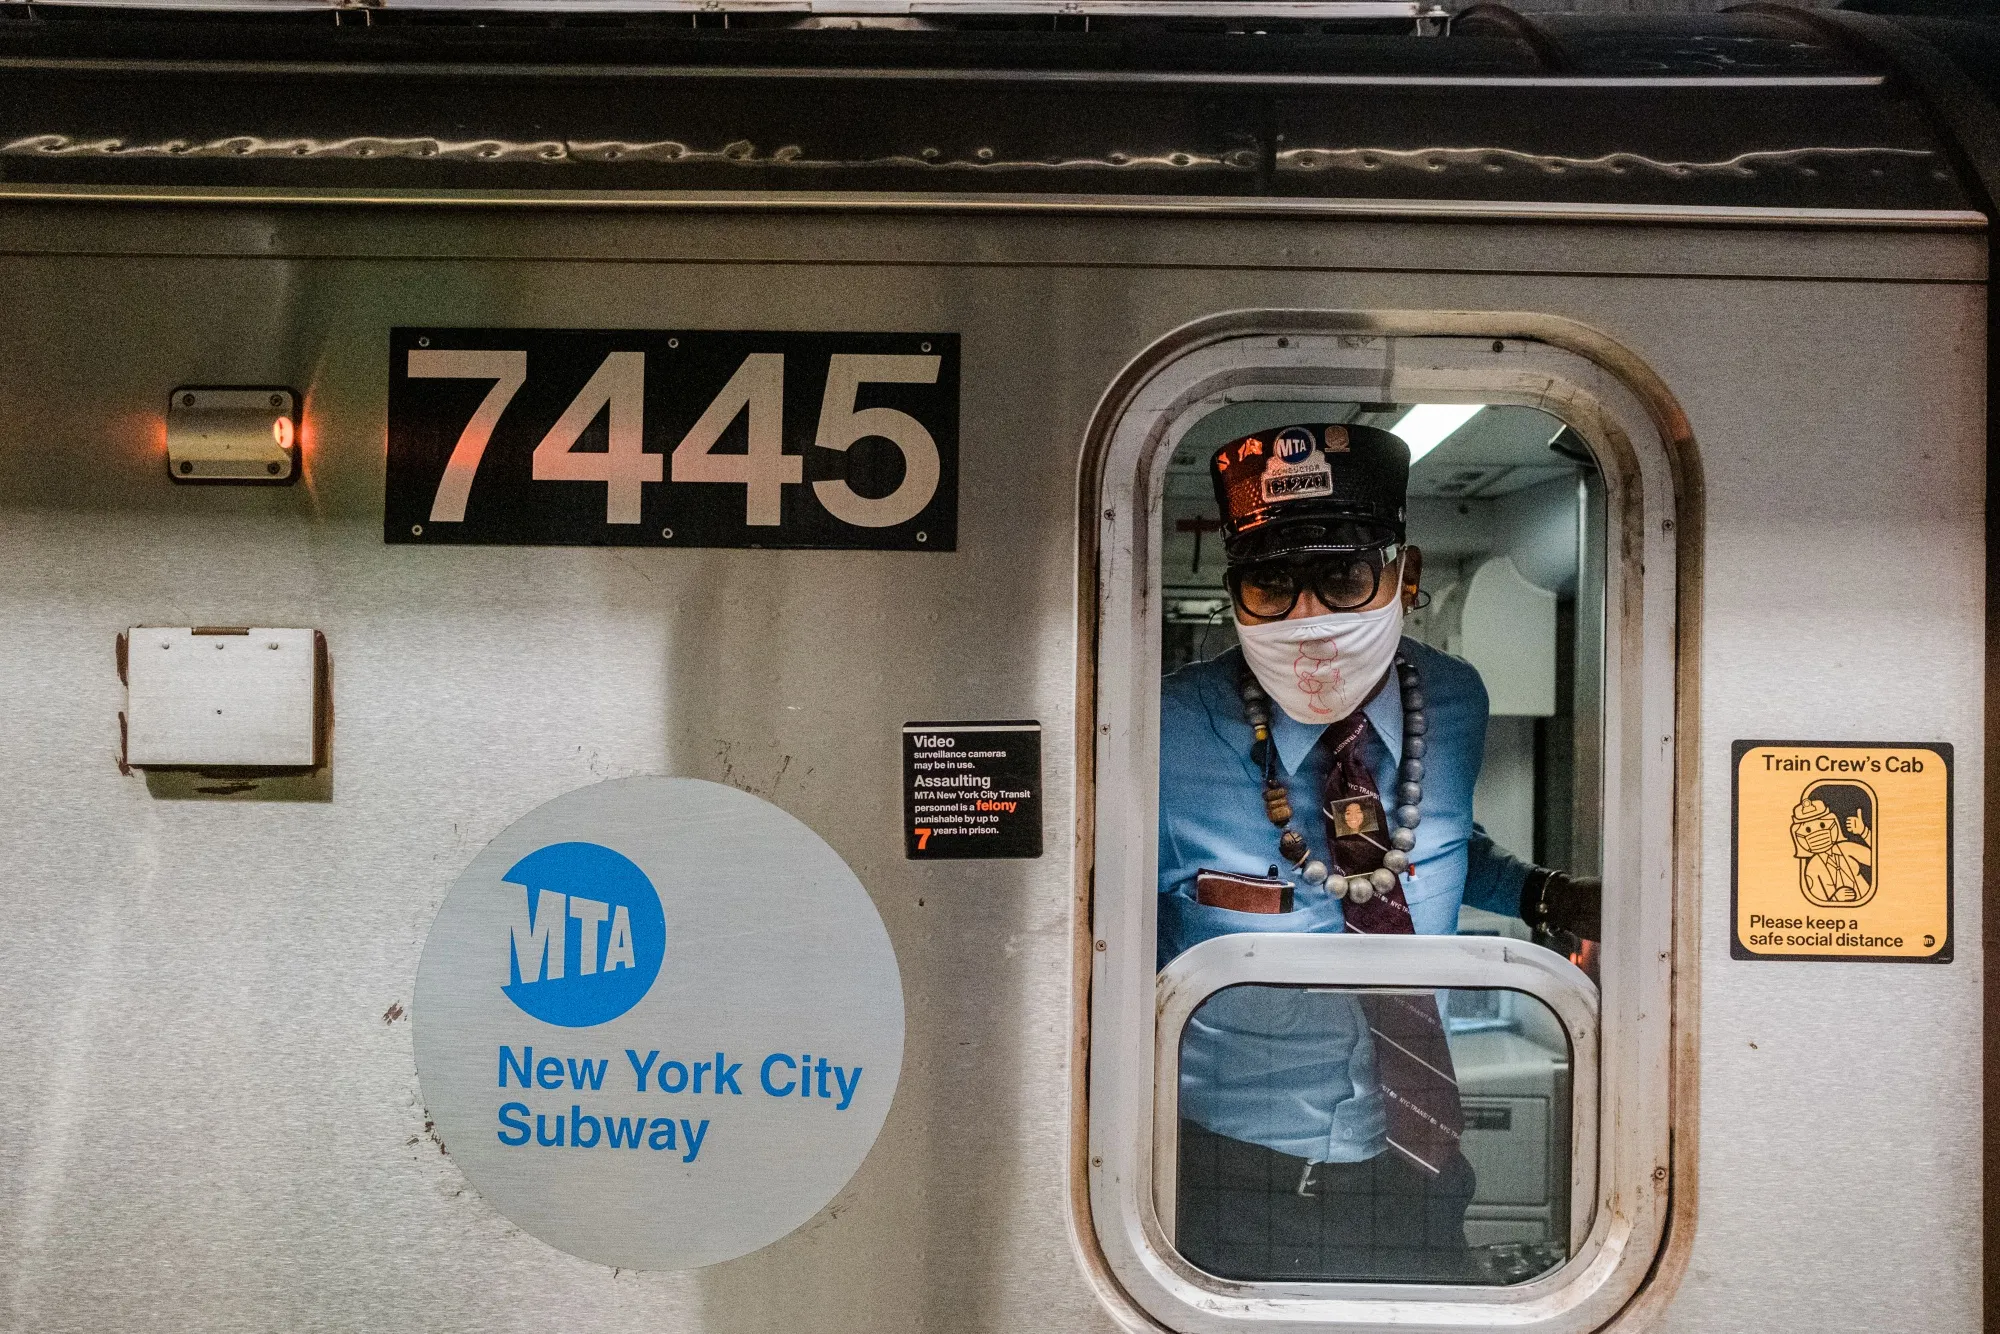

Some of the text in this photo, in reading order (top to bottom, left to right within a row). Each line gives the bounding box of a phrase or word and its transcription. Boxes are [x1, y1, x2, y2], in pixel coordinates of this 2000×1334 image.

[407, 349, 942, 528] 7445
[1276, 438, 1307, 458] MTA
[913, 735, 955, 748] Video
[1335, 723, 1364, 752] NYC TRANSIT
[914, 750, 1007, 759] surveillance cameras
[1762, 754, 1924, 773] Train Crew's Cab
[914, 761, 976, 771] may be in use.
[914, 774, 991, 789] Assaulting
[914, 790, 1031, 800] MTA New York City Transit
[914, 803, 959, 813] personnel
[960, 803, 968, 811] is
[976, 800, 1017, 813] felony
[915, 814, 999, 825] punishable by up to
[914, 826, 999, 850] 7 years in prison.
[1750, 914, 1858, 932] Please keep a
[500, 879, 636, 986] MTA
[1749, 932, 1903, 948] safe social distance
[498, 1045, 863, 1110] New York City
[1400, 1097, 1432, 1121] NYC TRANSIT
[497, 1101, 710, 1163] Subway
